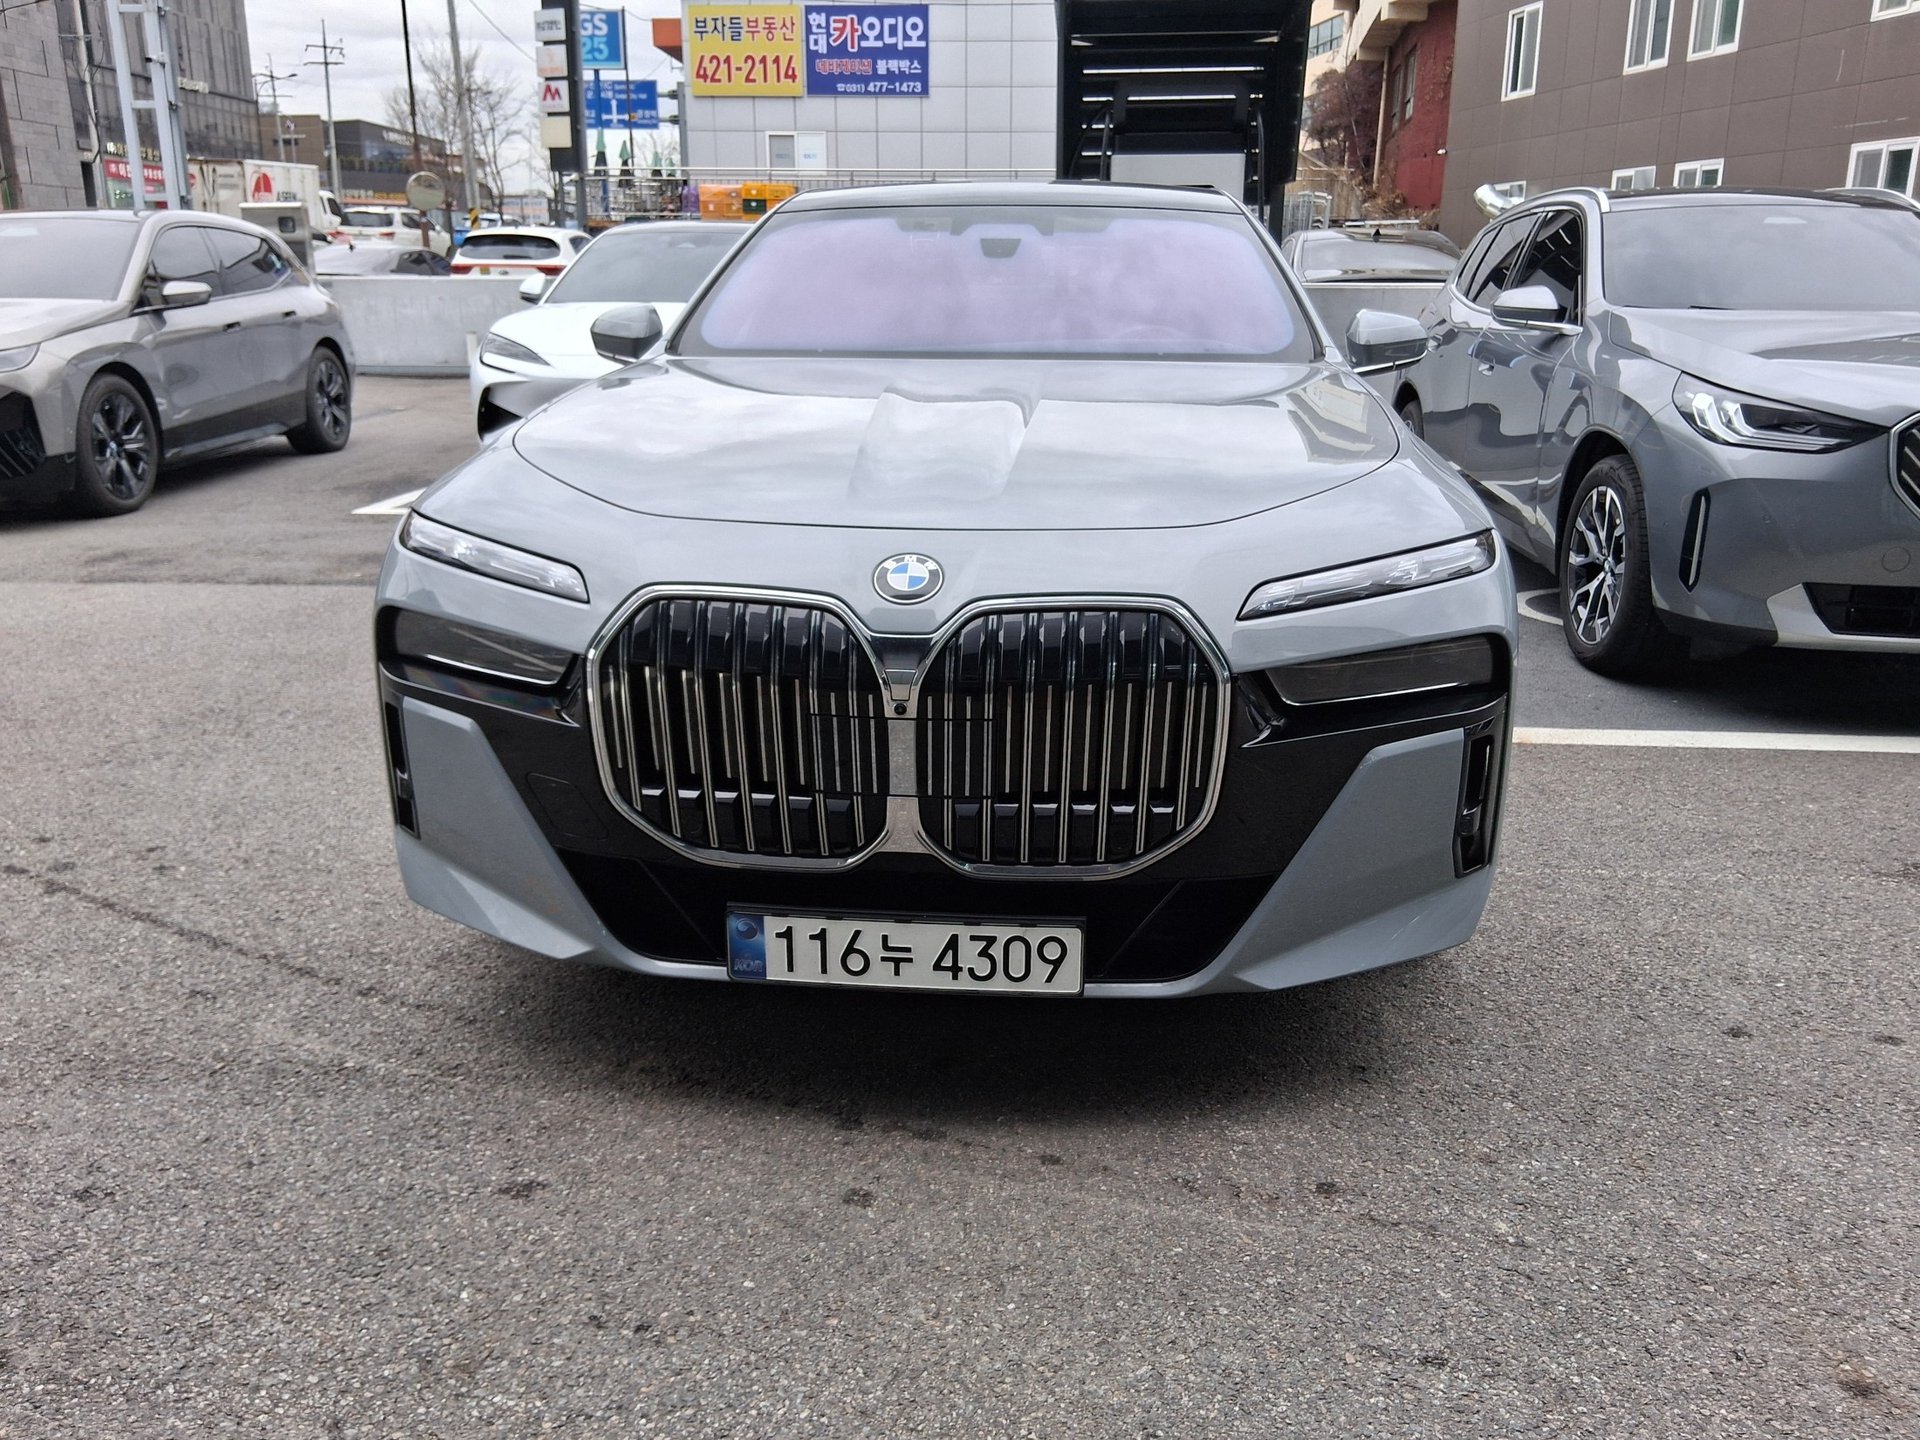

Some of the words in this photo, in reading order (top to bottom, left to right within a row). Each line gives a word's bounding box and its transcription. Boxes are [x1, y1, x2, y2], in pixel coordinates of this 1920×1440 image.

[580, 13, 608, 36] GS
[829, 15, 927, 51] 카오디오
[695, 54, 798, 84] 421-2114
[876, 59, 922, 75] 블랙박스
[867, 82, 922, 92] 477-1473
[883, 554, 938, 571] BMW
[774, 925, 914, 977] 116누
[931, 933, 1068, 984] 4309
[734, 958, 763, 973] KOR
